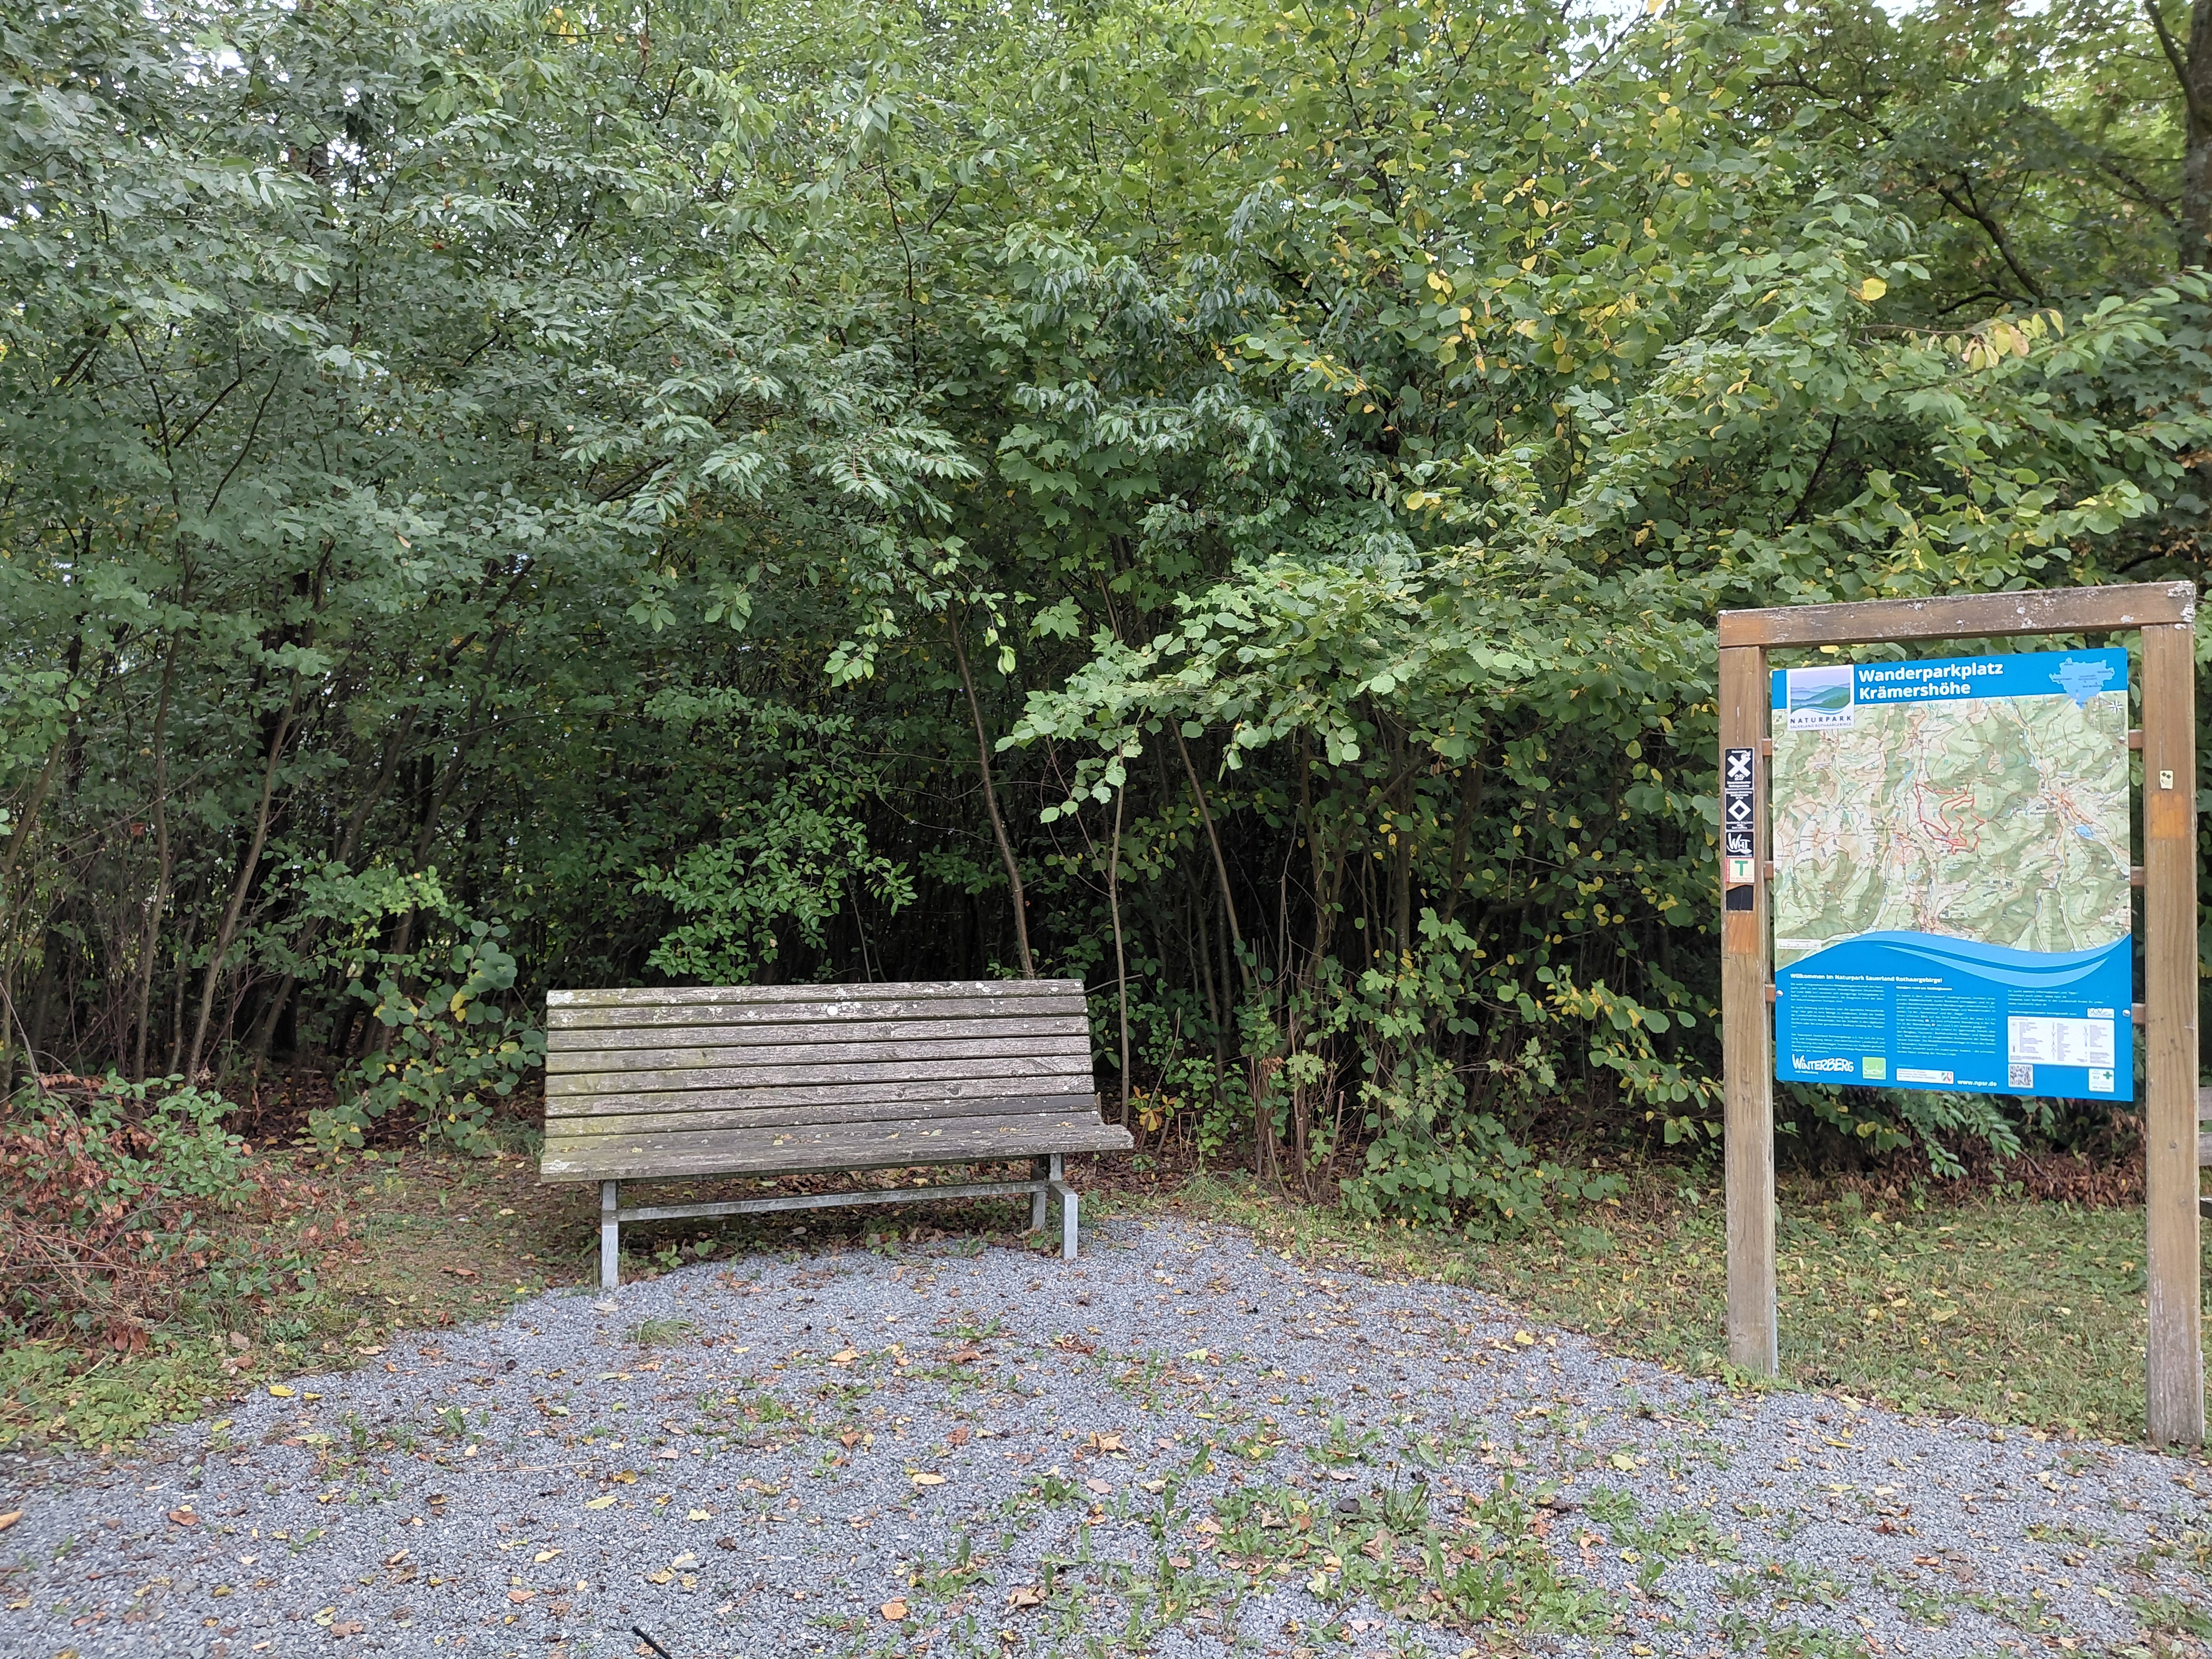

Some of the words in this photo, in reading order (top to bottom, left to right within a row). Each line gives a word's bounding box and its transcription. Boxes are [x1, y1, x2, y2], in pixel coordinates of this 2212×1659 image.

[1859, 663, 2004, 684] Wanderparkplatz
[1859, 681, 1971, 700] Krämershöhe
[1790, 715, 1852, 724] NATURPARK
[1734, 860, 1748, 877] T
[1835, 974, 1865, 982] Naturpark
[1895, 976, 1943, 984] Rothaargebirge!
